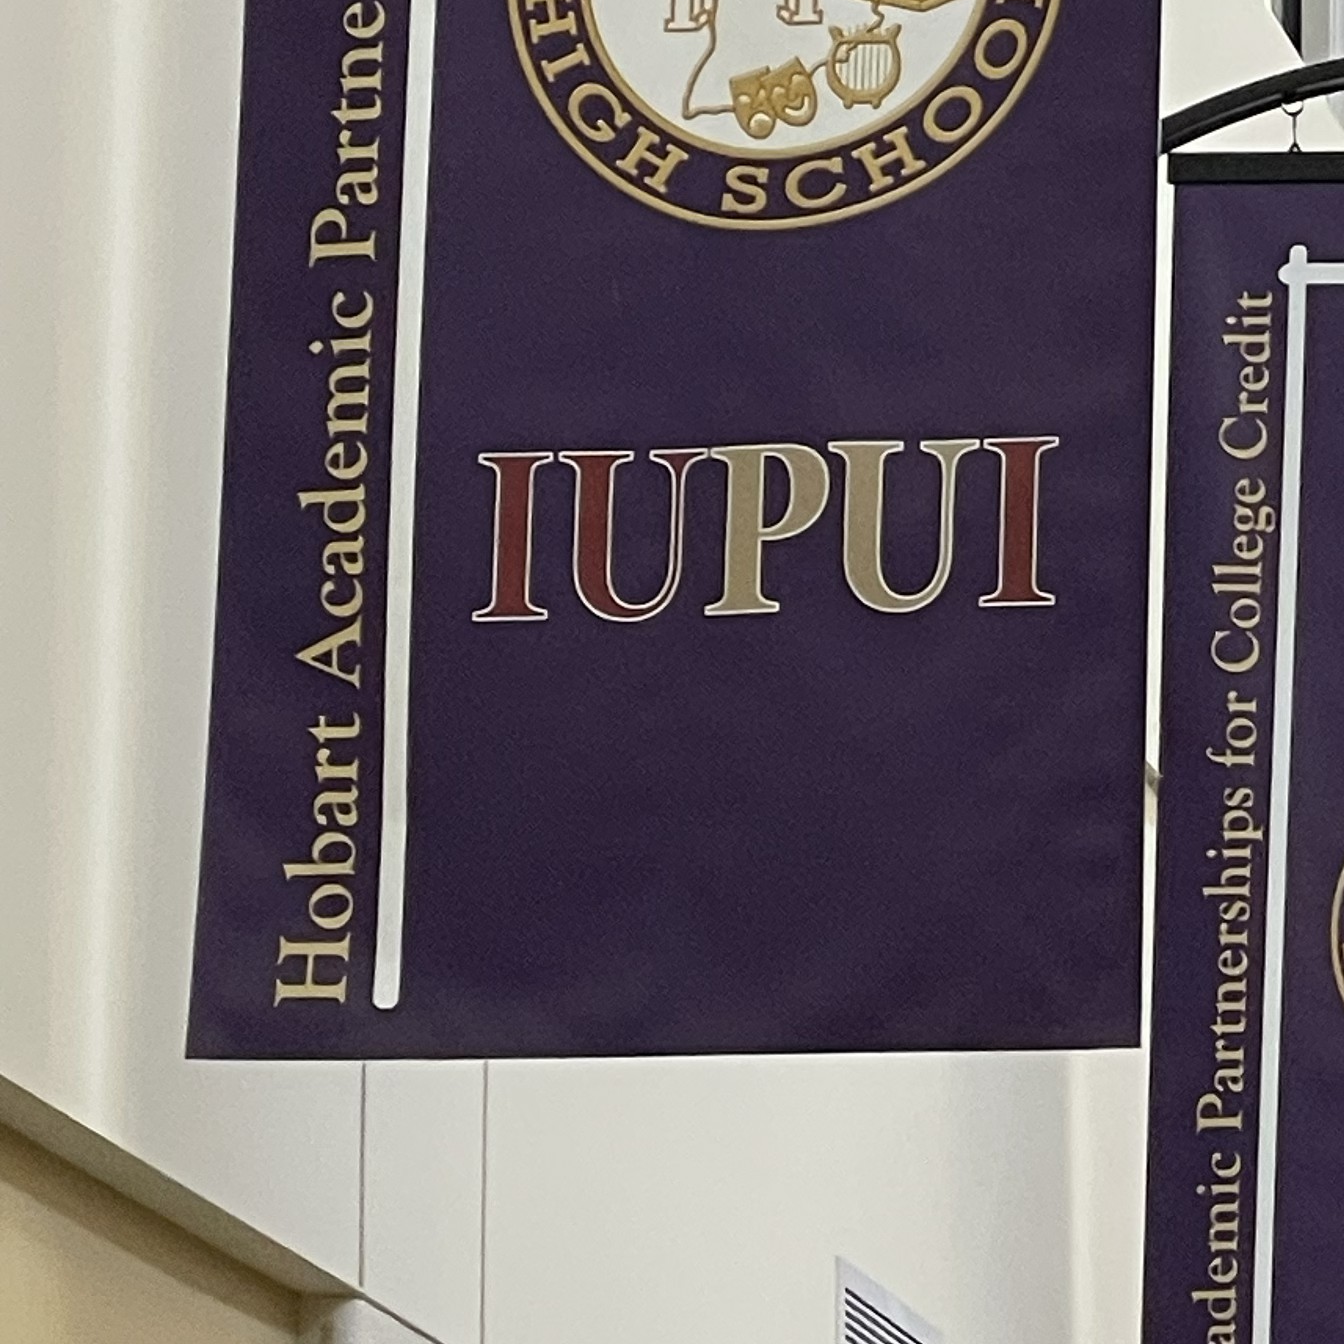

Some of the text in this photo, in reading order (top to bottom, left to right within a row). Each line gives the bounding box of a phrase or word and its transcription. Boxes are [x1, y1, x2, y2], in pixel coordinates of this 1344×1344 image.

[1218, 290, 1273, 460] Credit
[295, 291, 374, 689] Academic
[470, 434, 1060, 624] IUPUI
[1210, 477, 1277, 674] College
[1205, 690, 1258, 768] for
[273, 712, 361, 1007] Hobart
[1196, 787, 1263, 1134] Partnerships
